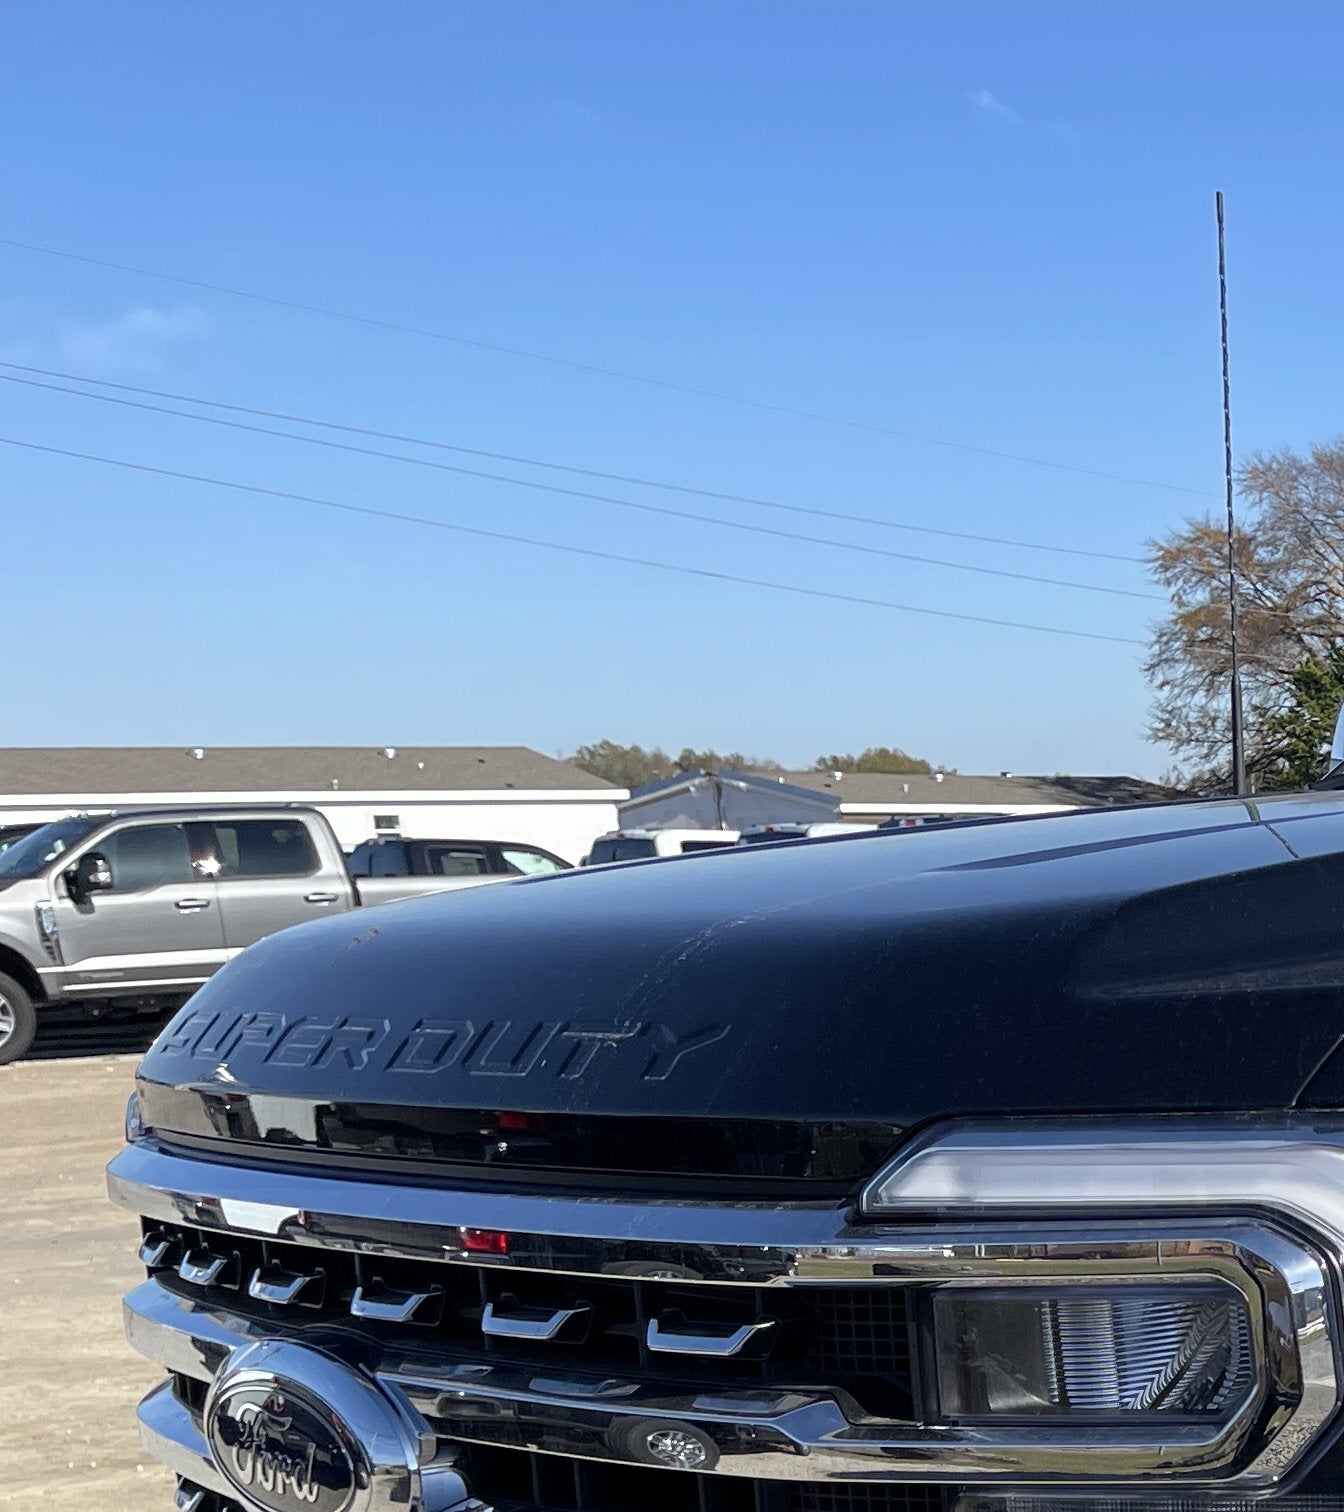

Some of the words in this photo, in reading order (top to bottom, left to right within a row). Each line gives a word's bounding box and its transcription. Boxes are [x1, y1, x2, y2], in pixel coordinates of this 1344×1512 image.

[160, 1011, 391, 1071] SUPER
[385, 1021, 731, 1081] DUTY
[232, 1402, 320, 1503] Ford
